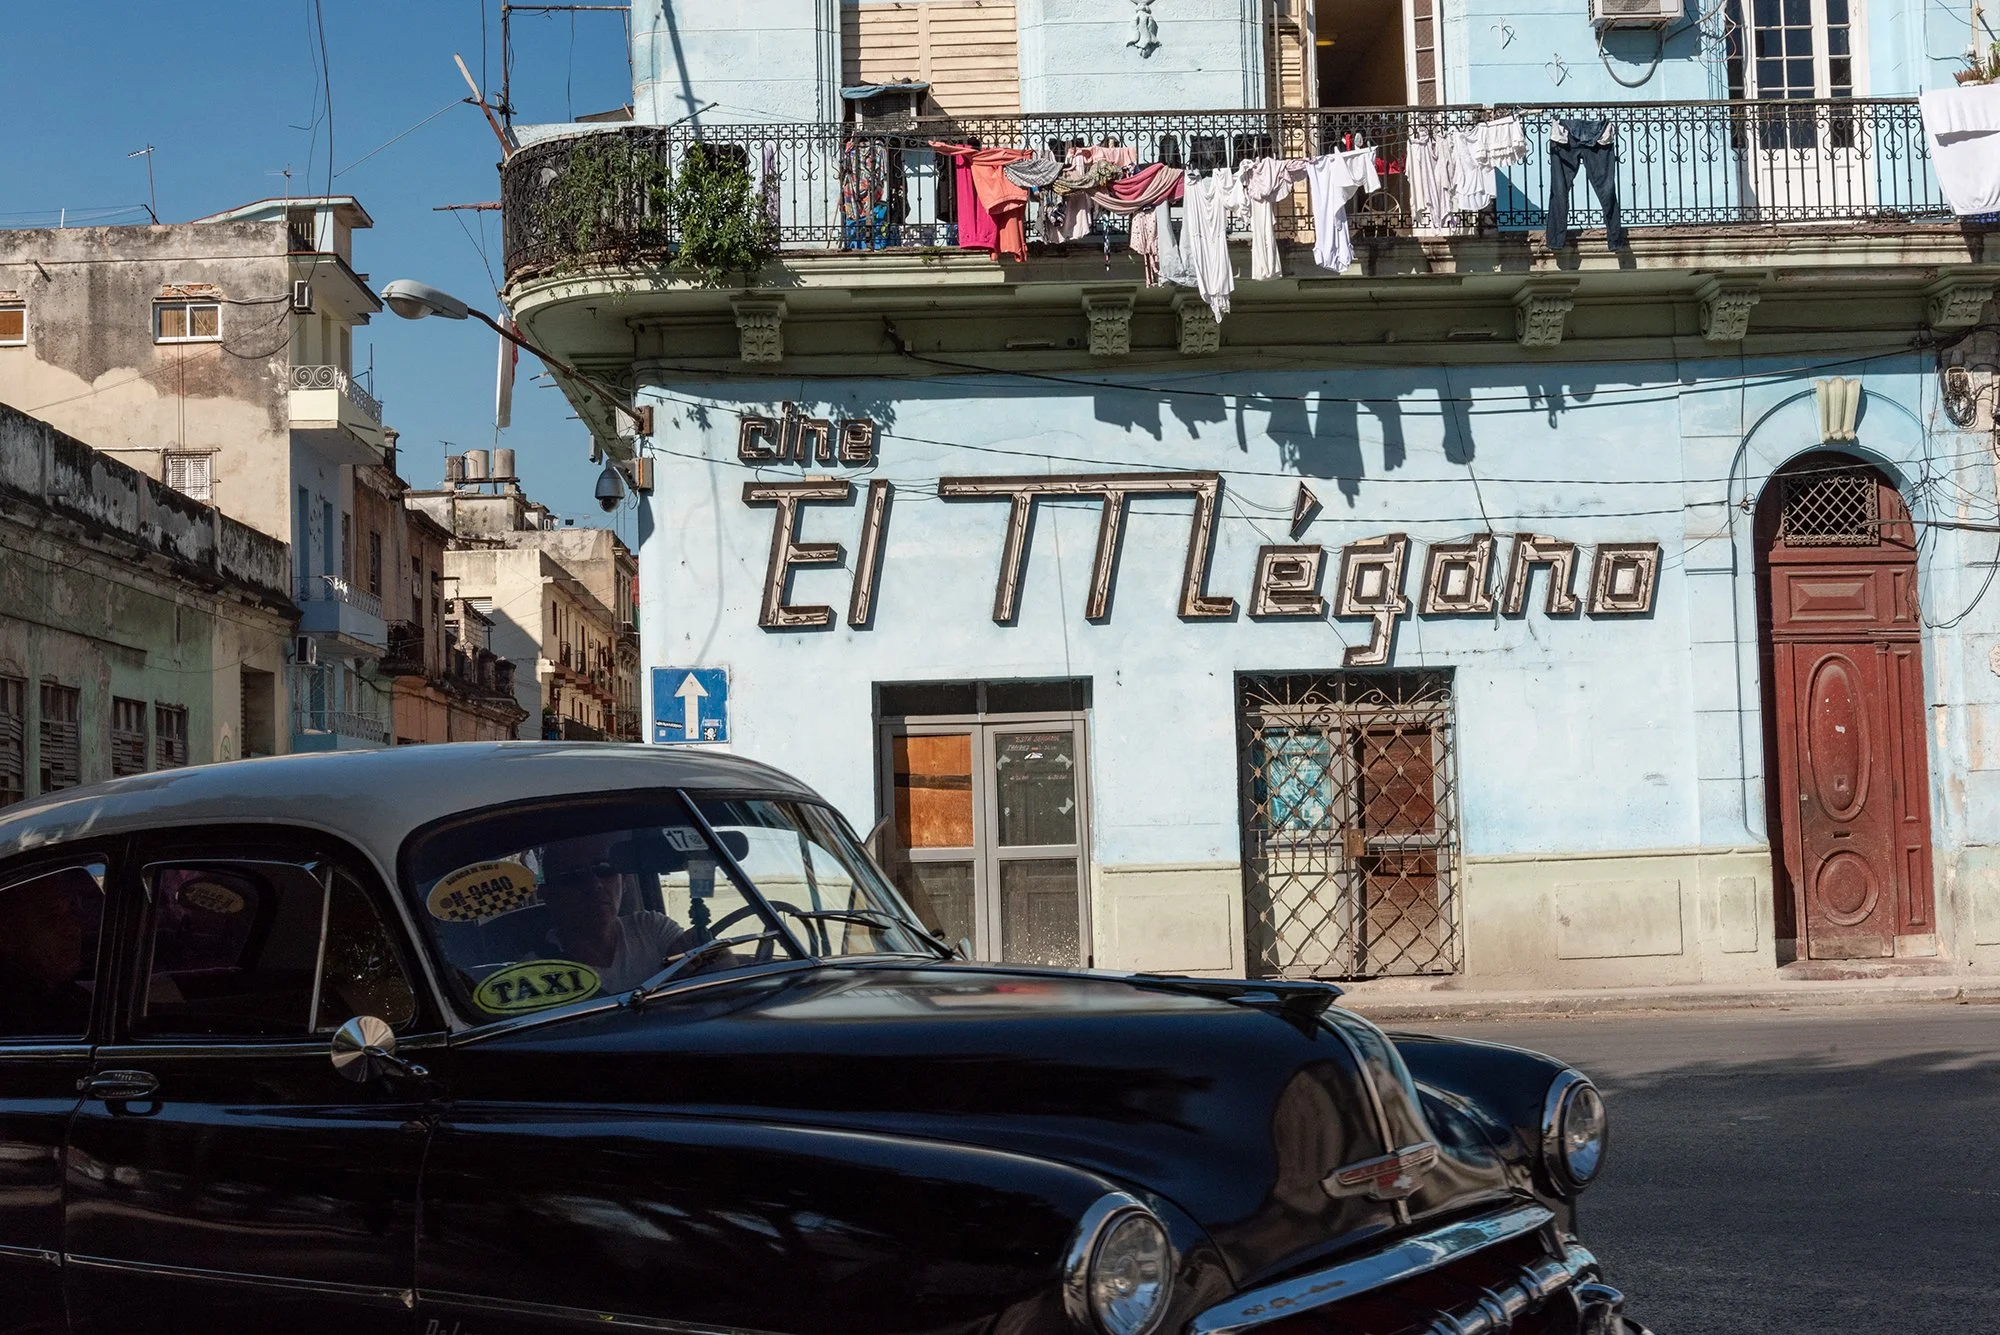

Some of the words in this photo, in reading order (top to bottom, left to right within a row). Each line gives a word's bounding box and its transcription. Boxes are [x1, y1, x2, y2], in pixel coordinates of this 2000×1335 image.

[738, 401, 874, 462] cine
[741, 479, 893, 629] El
[666, 830, 689, 848] 17
[491, 970, 585, 1004] TAXI
